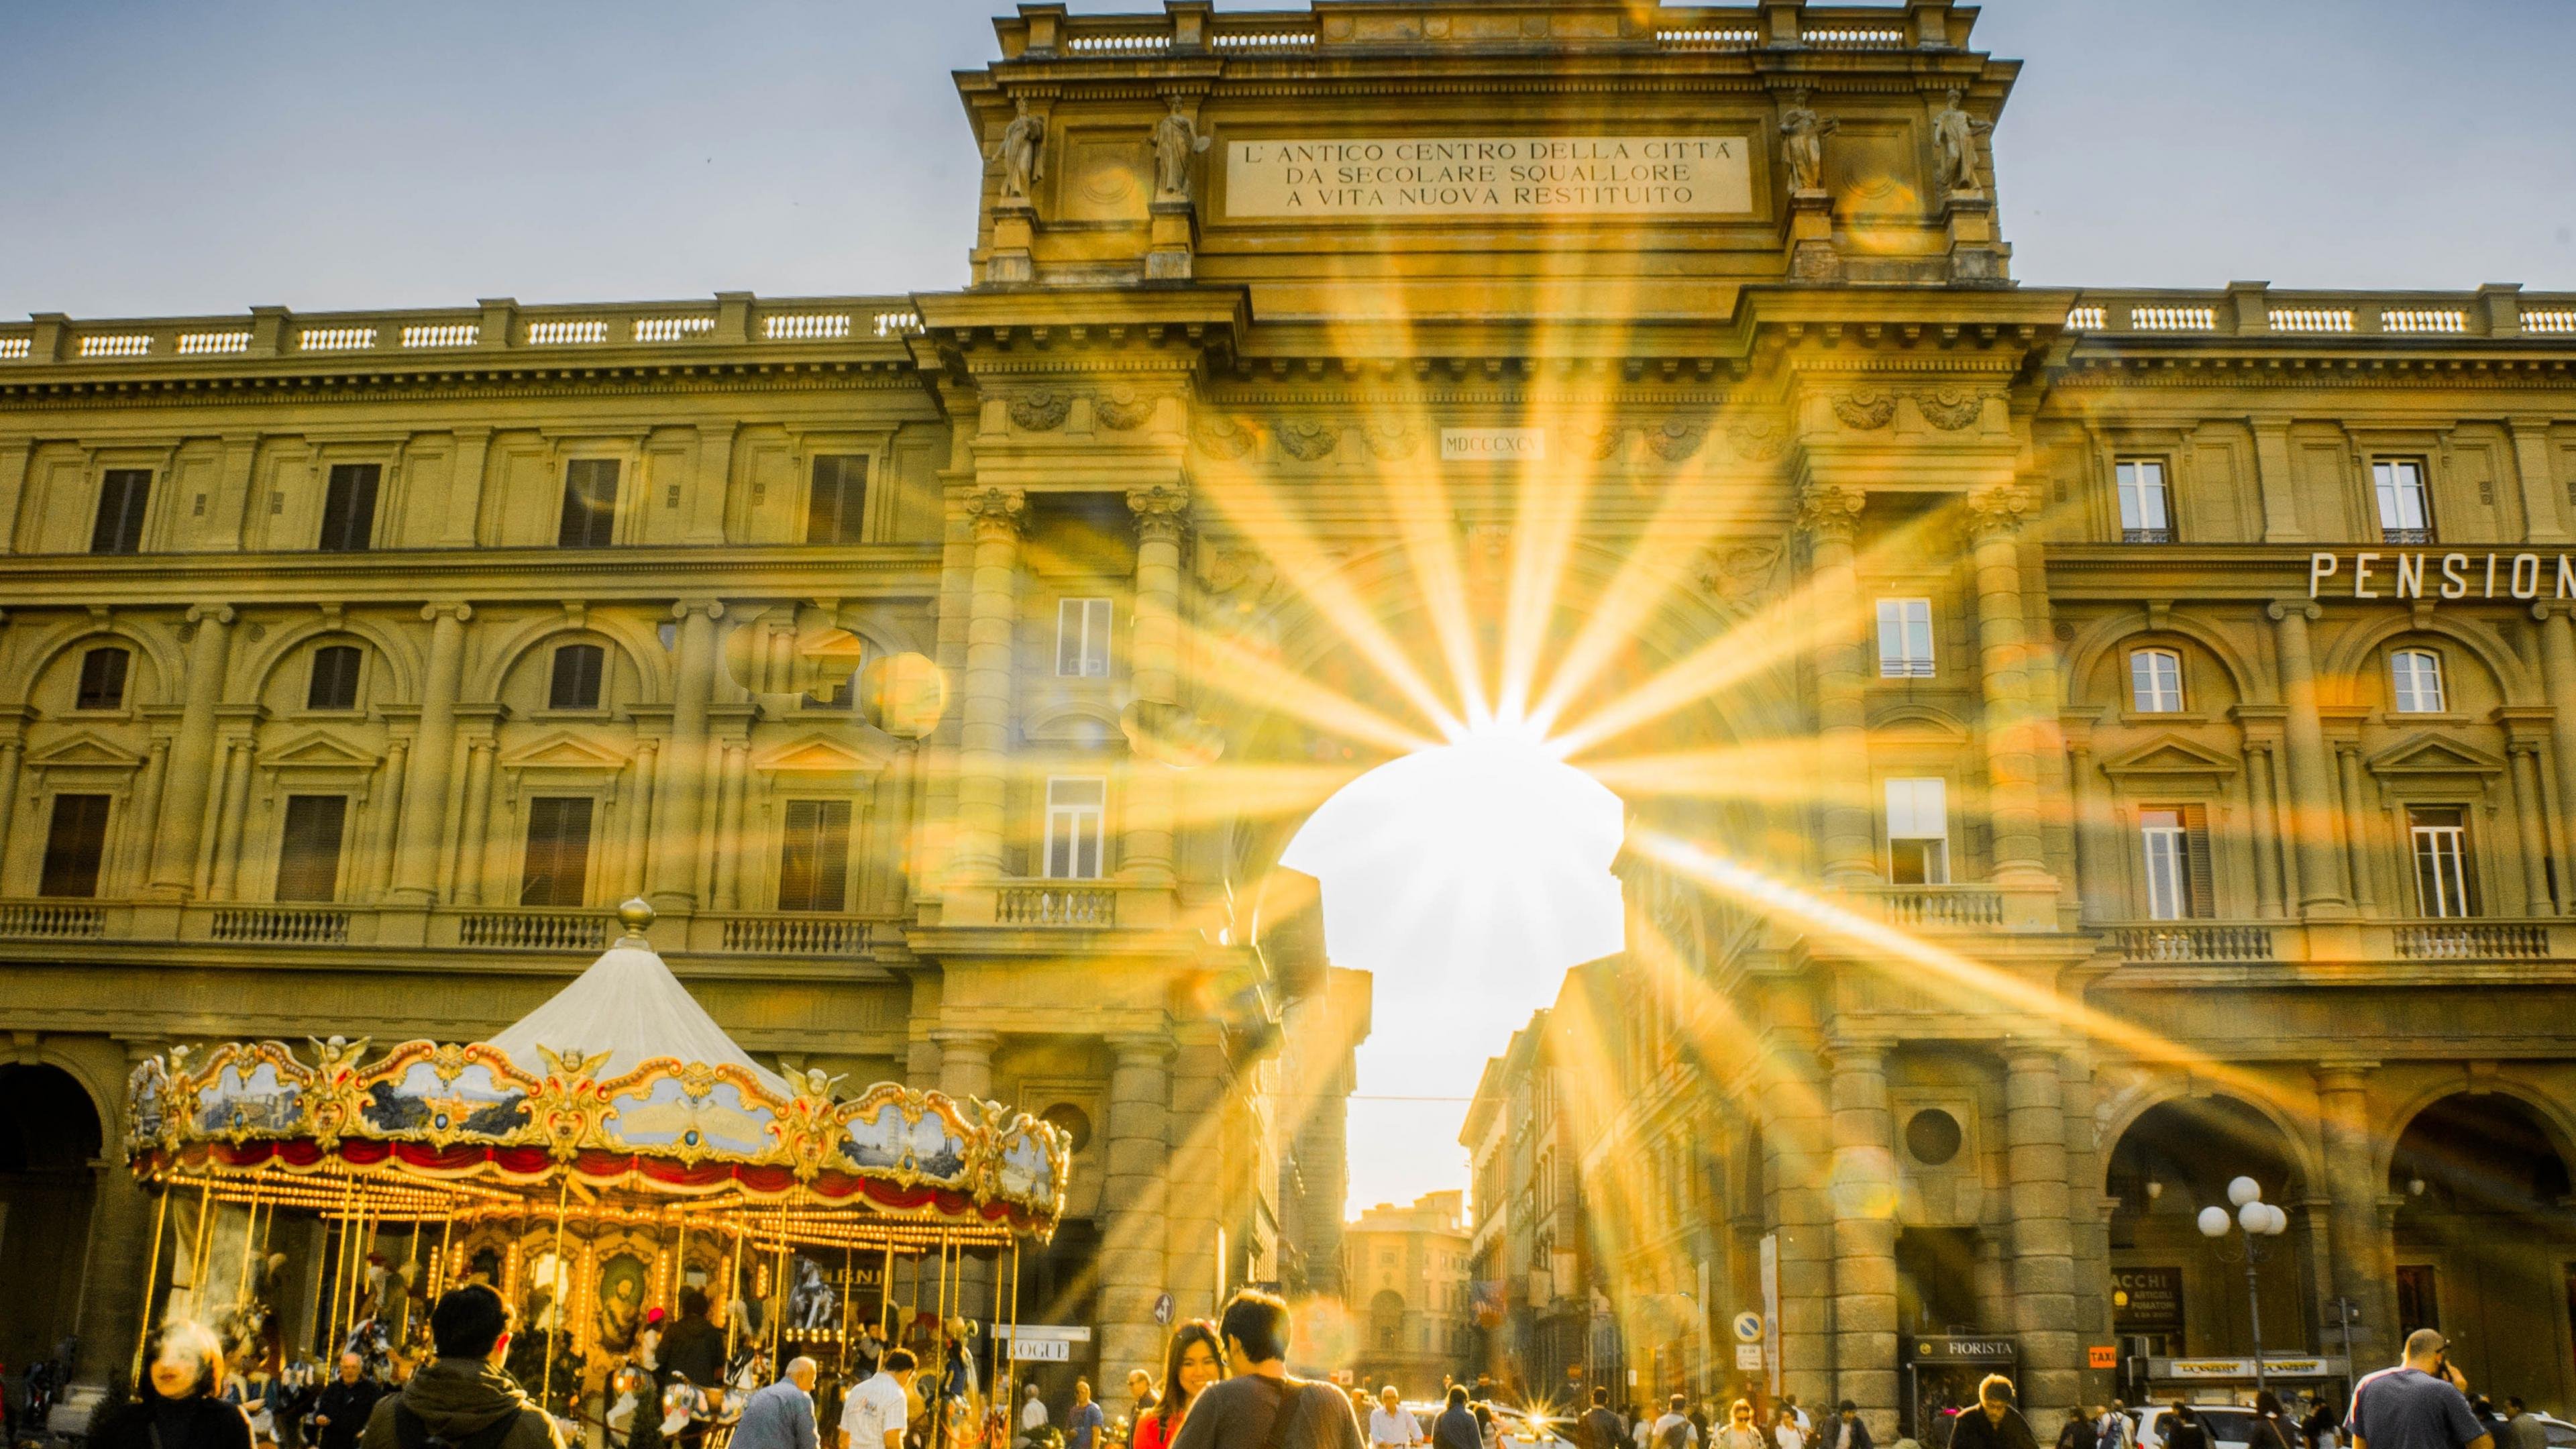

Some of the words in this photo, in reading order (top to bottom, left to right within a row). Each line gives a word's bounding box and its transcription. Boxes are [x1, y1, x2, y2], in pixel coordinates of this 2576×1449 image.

[1278, 144, 1383, 162] ANTICO
[1396, 143, 1516, 161] CENTRO
[1530, 142, 1629, 160] DELLA
[1286, 168, 1323, 184] DA
[1338, 166, 1497, 184] SECOLARE
[1510, 164, 1691, 183] SQUALLORE
[1287, 191, 1302, 207] A
[1318, 189, 1384, 206] VITA
[1399, 188, 1499, 206] NUOVA
[1515, 186, 1693, 204] RESTITUITO
[2310, 553, 2576, 599] PENSION
[1009, 1342, 1068, 1358] OGUE
[1949, 1342, 2012, 1354] FIORISTA
[2091, 1352, 2116, 1362] TAXI
